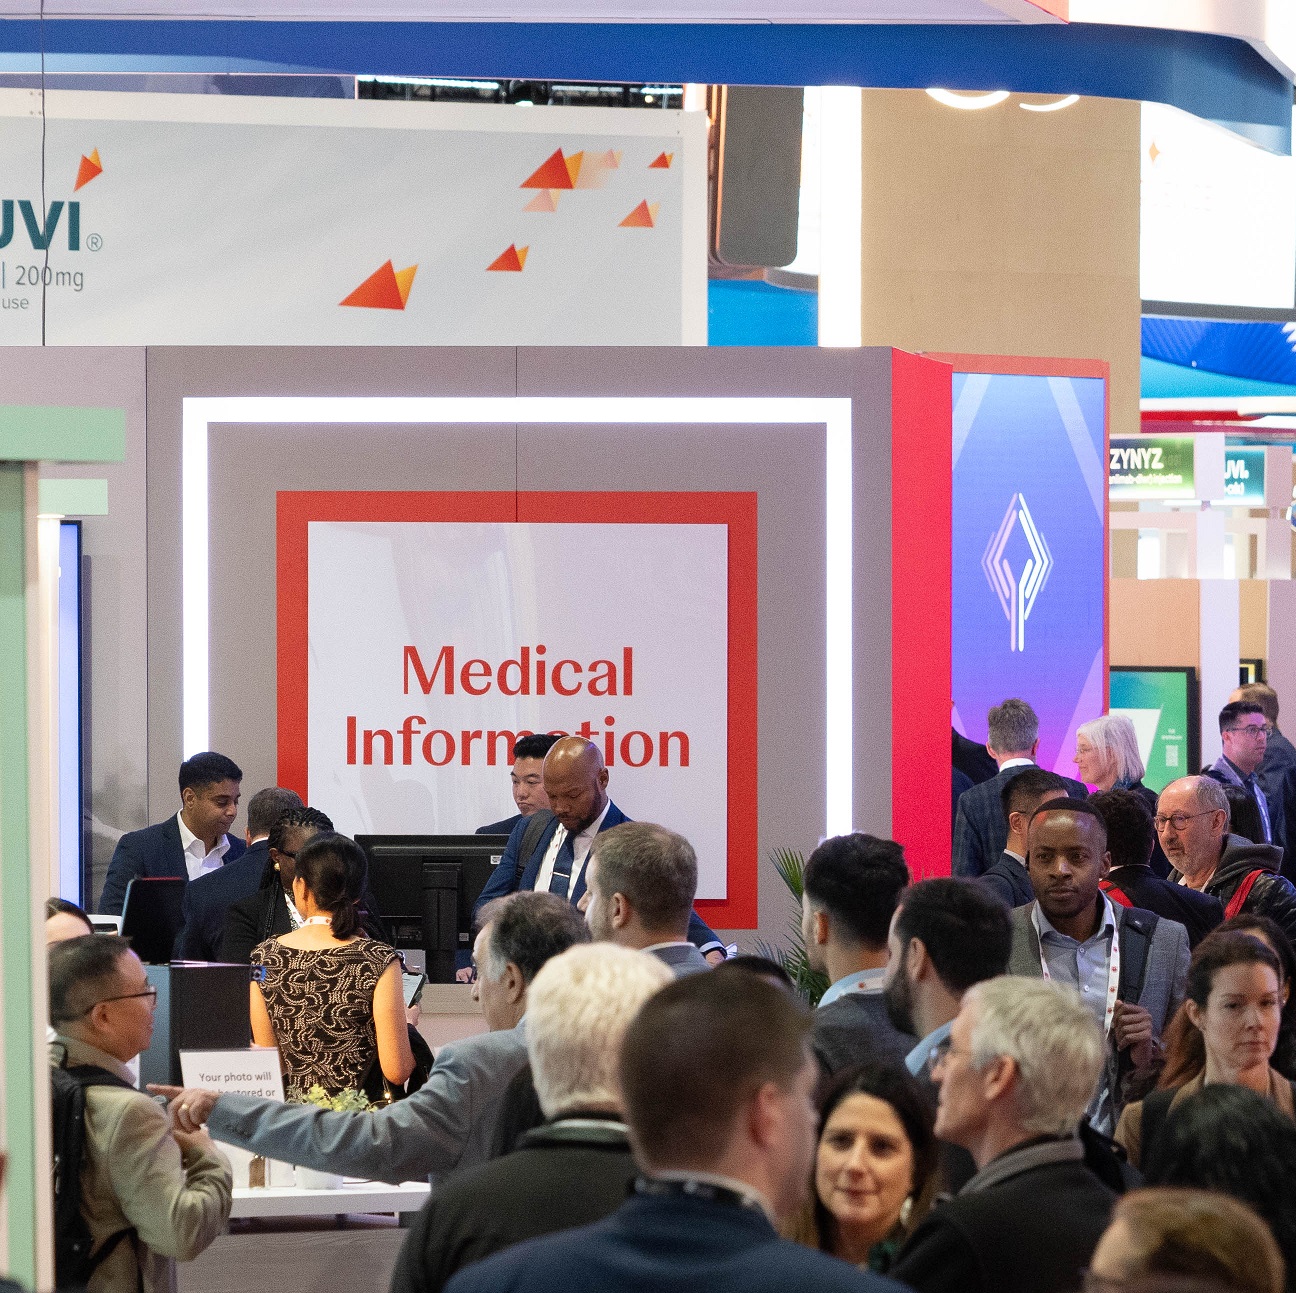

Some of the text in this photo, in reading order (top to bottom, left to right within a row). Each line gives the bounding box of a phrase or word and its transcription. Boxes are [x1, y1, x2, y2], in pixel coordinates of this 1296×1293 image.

[2, 297, 29, 309] use
[1109, 448, 1165, 470] ZYNYZ
[403, 644, 633, 696] Medical
[199, 1072, 272, 1082] Your photo will
